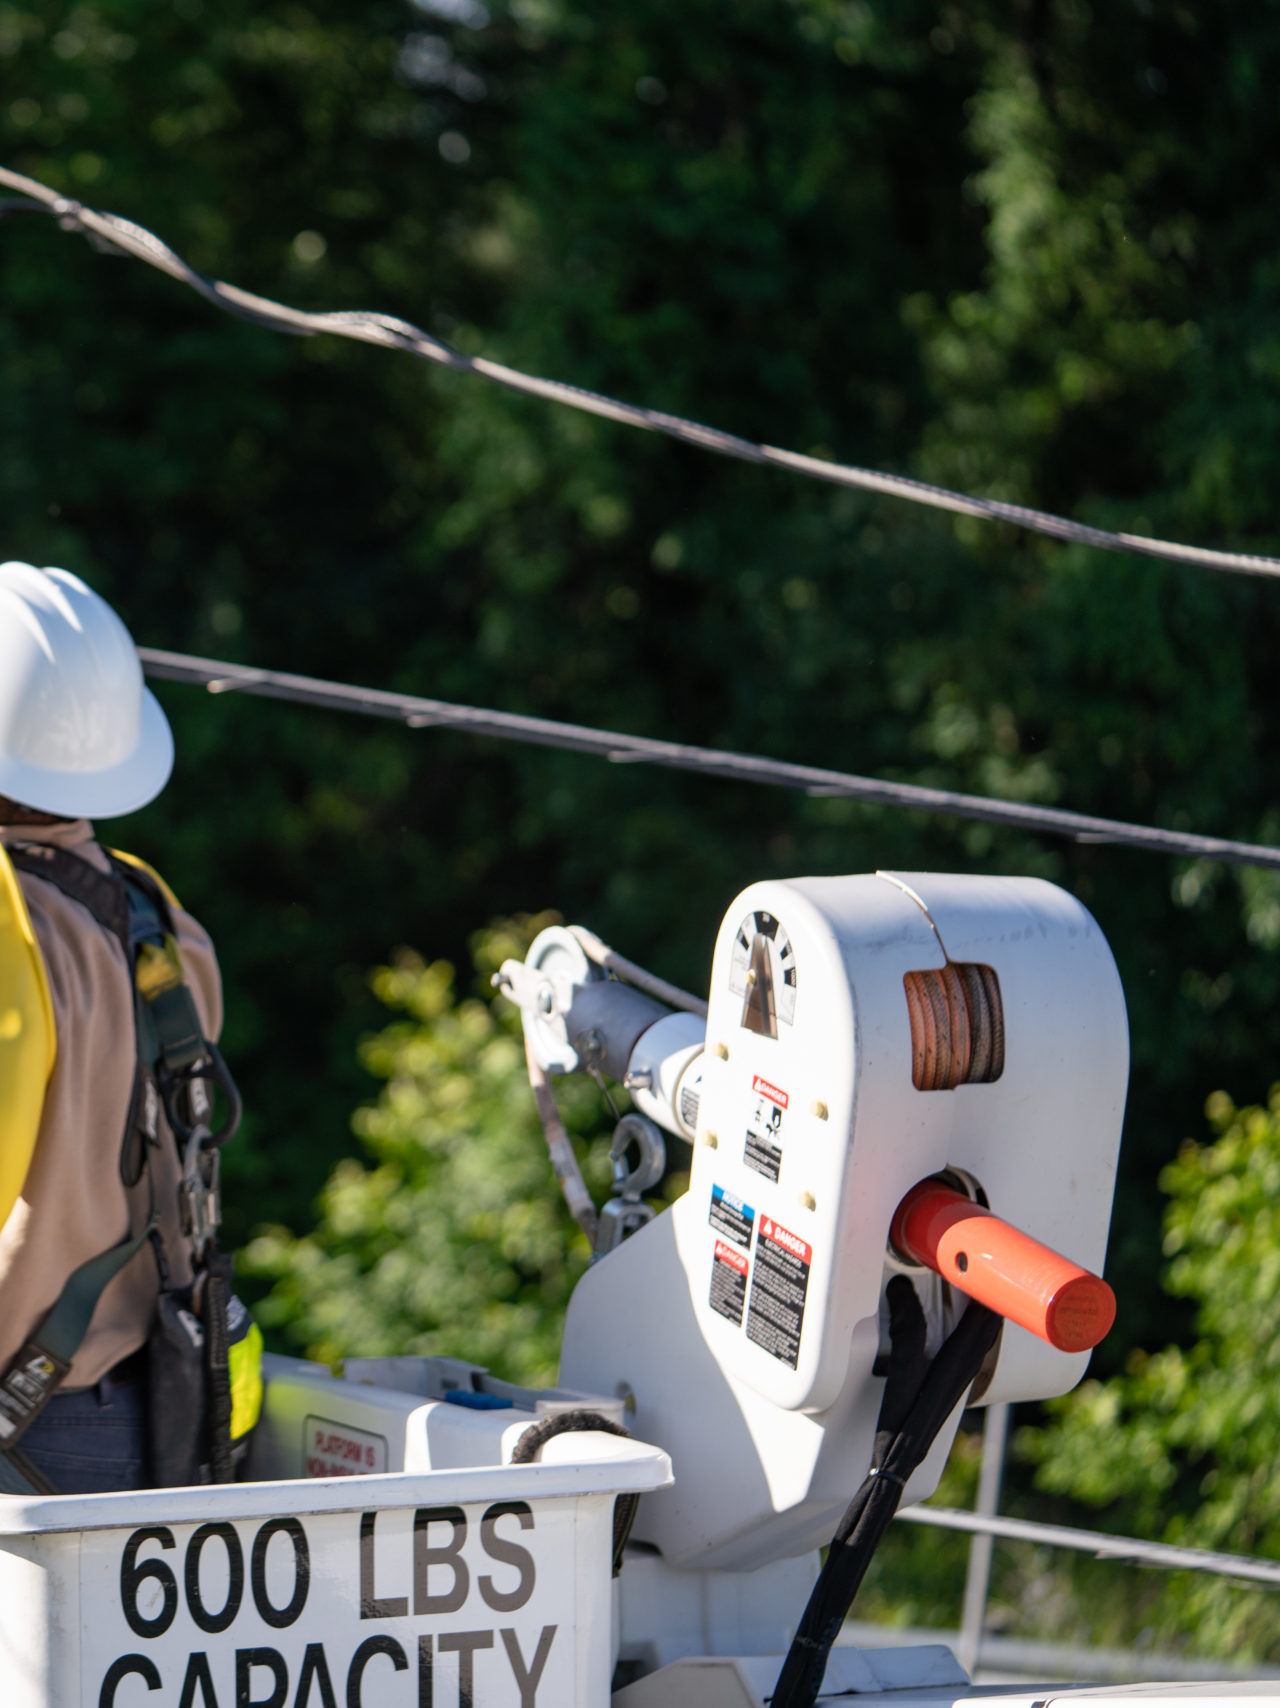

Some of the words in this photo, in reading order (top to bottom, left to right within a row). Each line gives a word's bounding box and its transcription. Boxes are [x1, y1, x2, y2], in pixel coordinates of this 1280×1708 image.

[774, 1226, 807, 1257] DANGER
[315, 1431, 363, 1464] PLATFORM
[120, 1516, 311, 1640] 600
[360, 1500, 537, 1620] LBS
